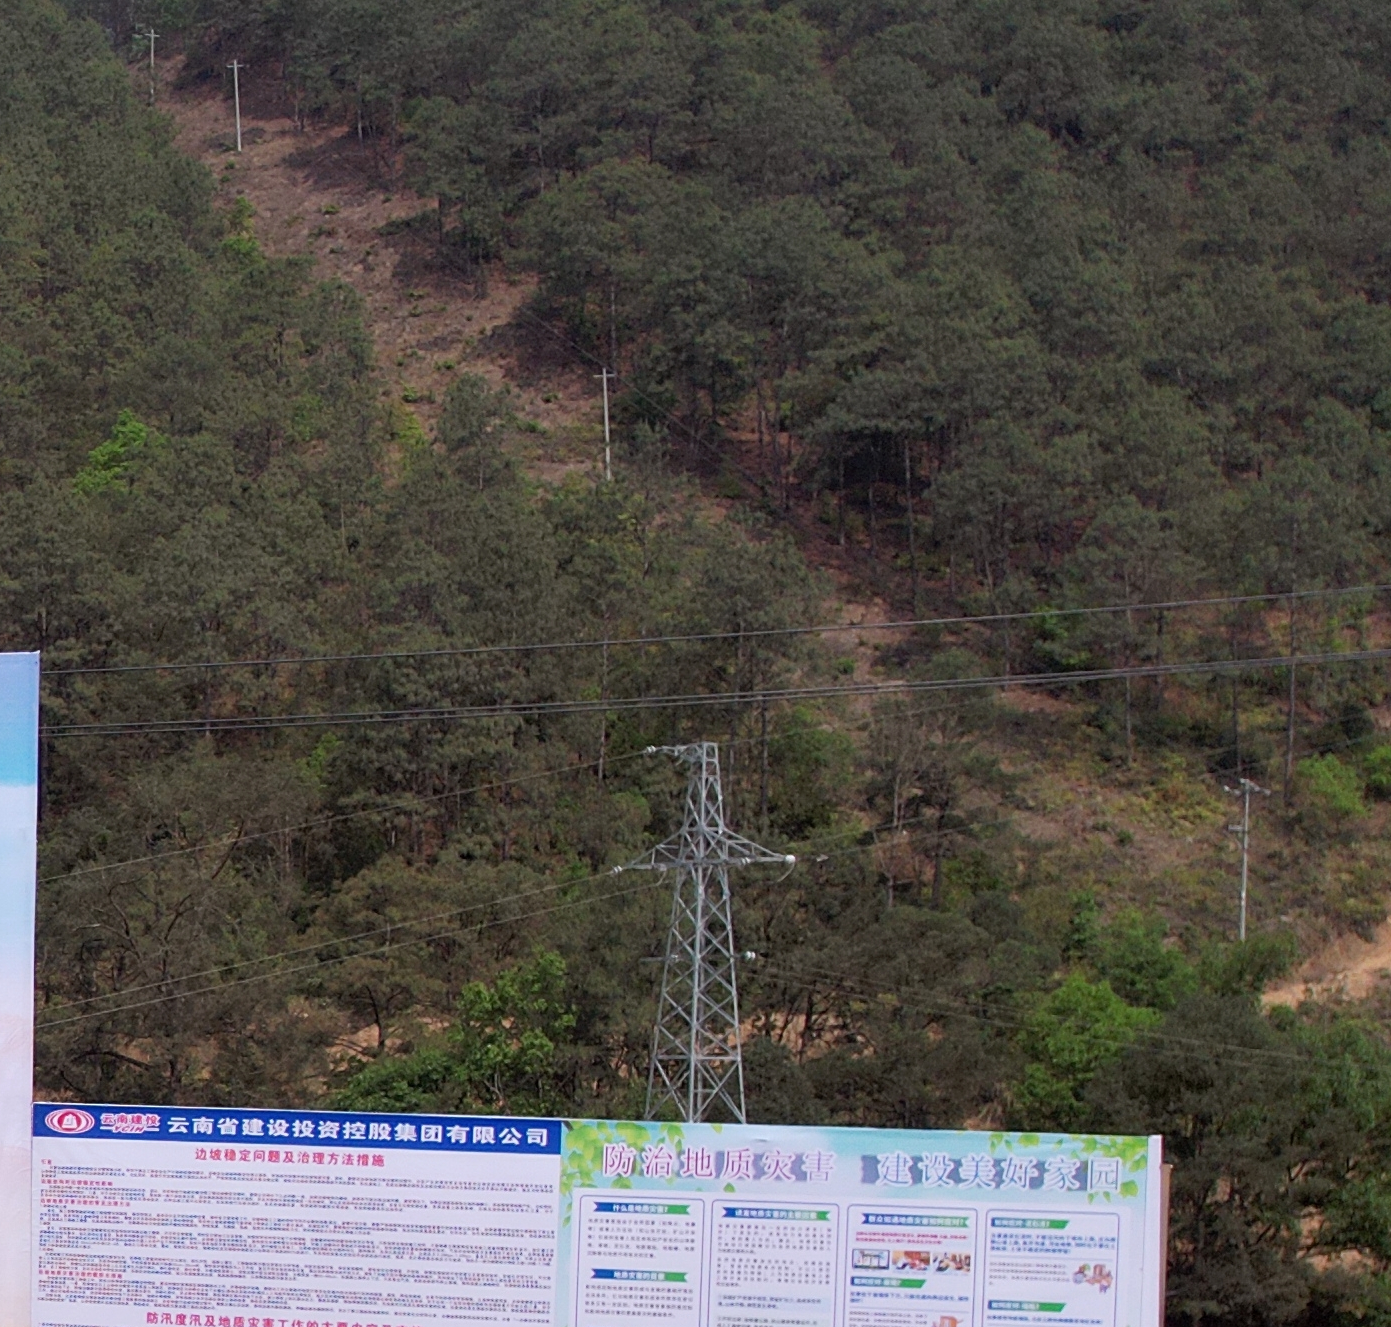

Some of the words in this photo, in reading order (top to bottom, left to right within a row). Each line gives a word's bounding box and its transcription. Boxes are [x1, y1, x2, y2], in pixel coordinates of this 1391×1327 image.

[167, 1116, 548, 1146] 云南省建设投资控股集团有限公司
[195, 1147, 386, 1168] 边坡稳定问题及治理方法措施
[603, 1143, 837, 1182] 防治地质灾害
[876, 1152, 1120, 1193] 建设美好家园
